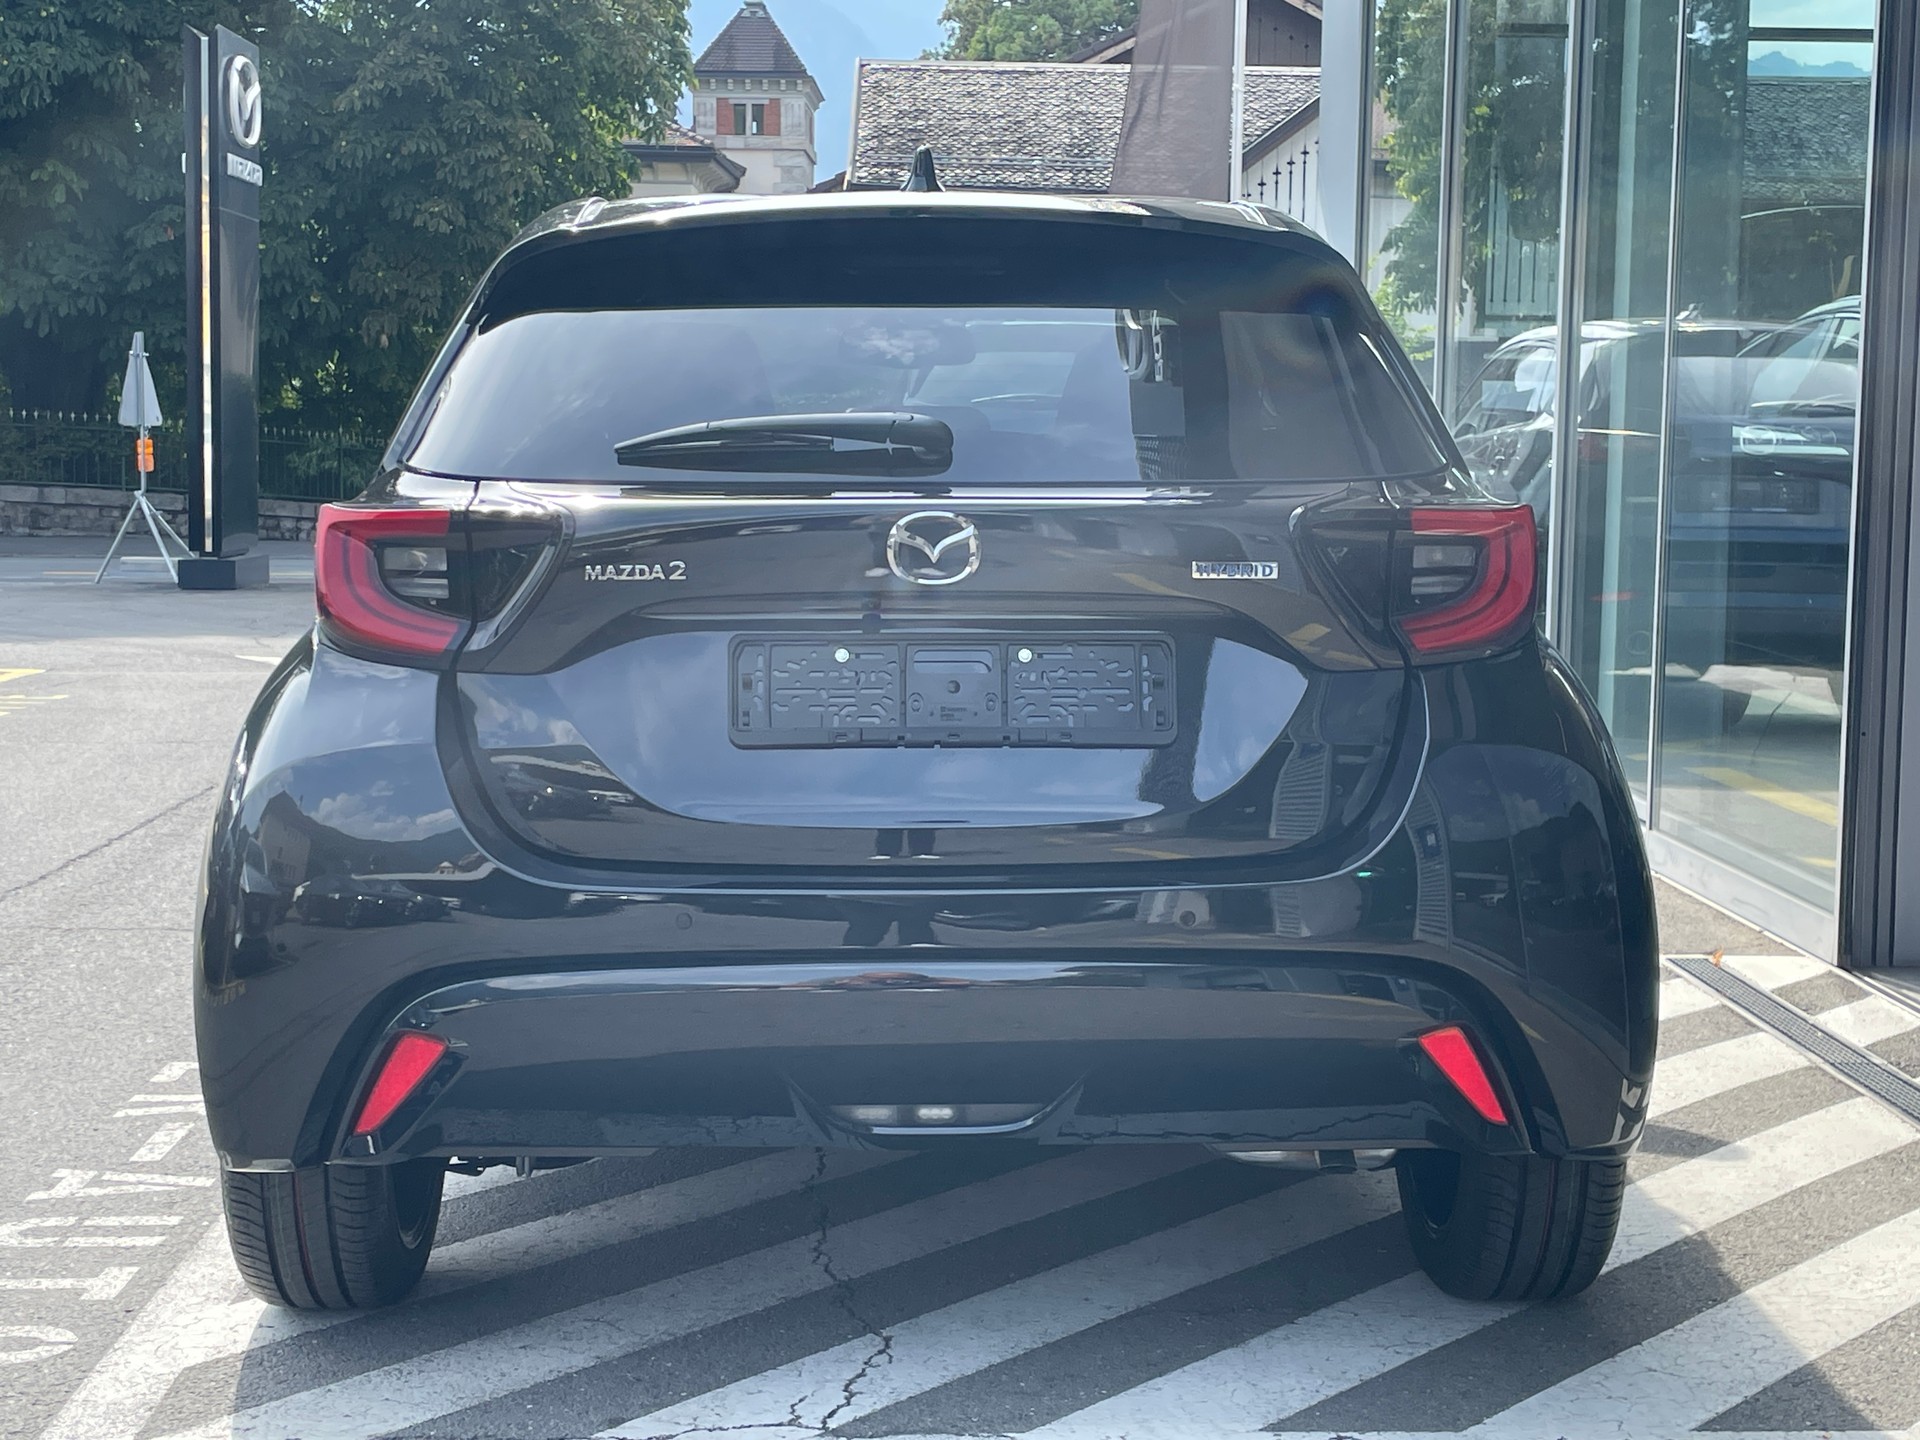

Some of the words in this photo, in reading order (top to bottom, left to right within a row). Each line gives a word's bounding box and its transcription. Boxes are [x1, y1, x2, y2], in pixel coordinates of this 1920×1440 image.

[585, 565, 666, 580] MAZDA
[668, 561, 687, 580] 2
[1196, 563, 1274, 577] HYBRID
